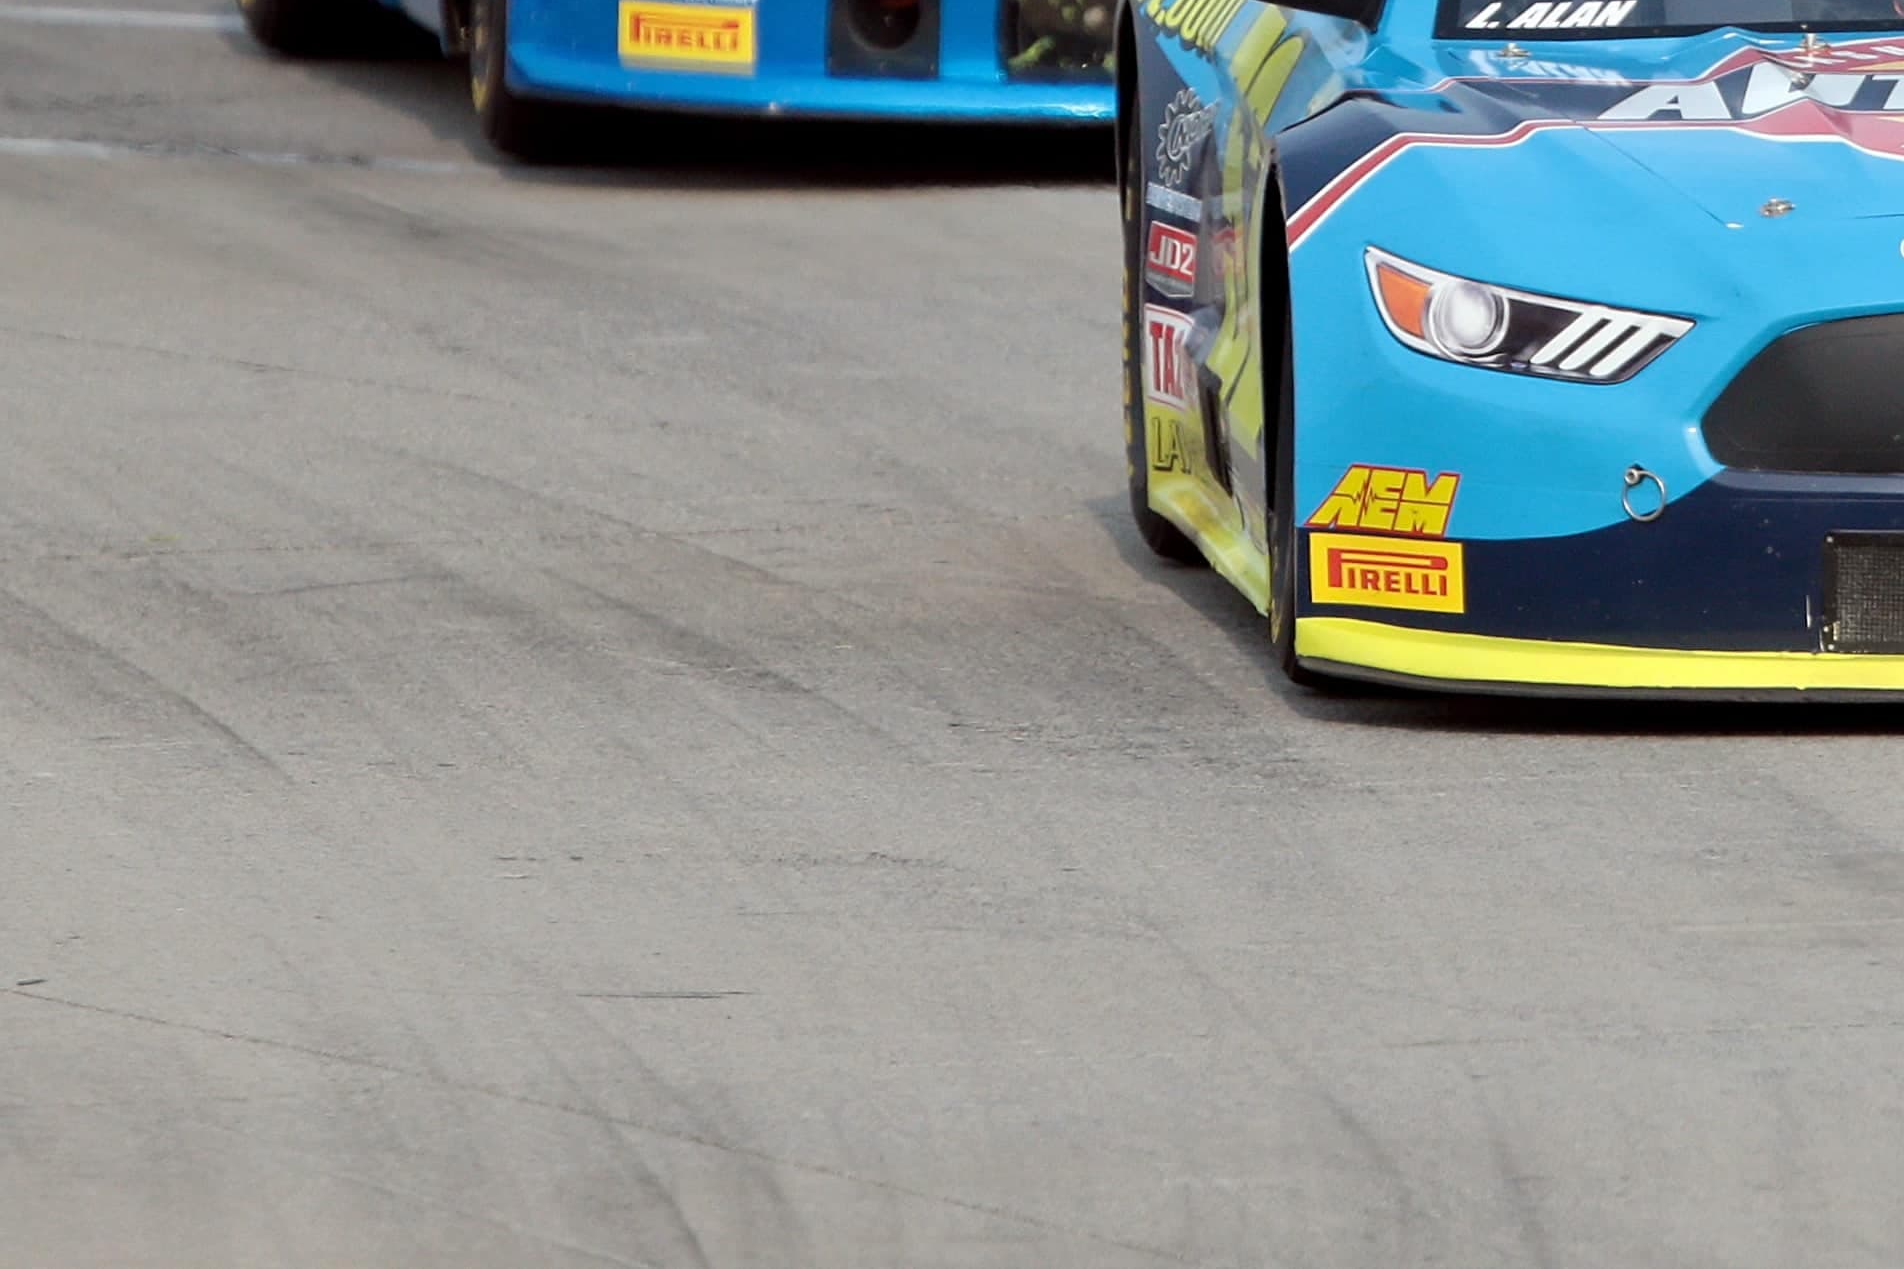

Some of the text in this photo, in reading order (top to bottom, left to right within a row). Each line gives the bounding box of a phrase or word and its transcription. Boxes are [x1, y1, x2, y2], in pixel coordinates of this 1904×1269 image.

[629, 10, 740, 52] PIRELLI
[1464, 0, 1638, 29] L. ALAN
[1149, 235, 1194, 277] JD2
[1303, 463, 1461, 538] AEM
[1327, 548, 1448, 598] PIRELLI
